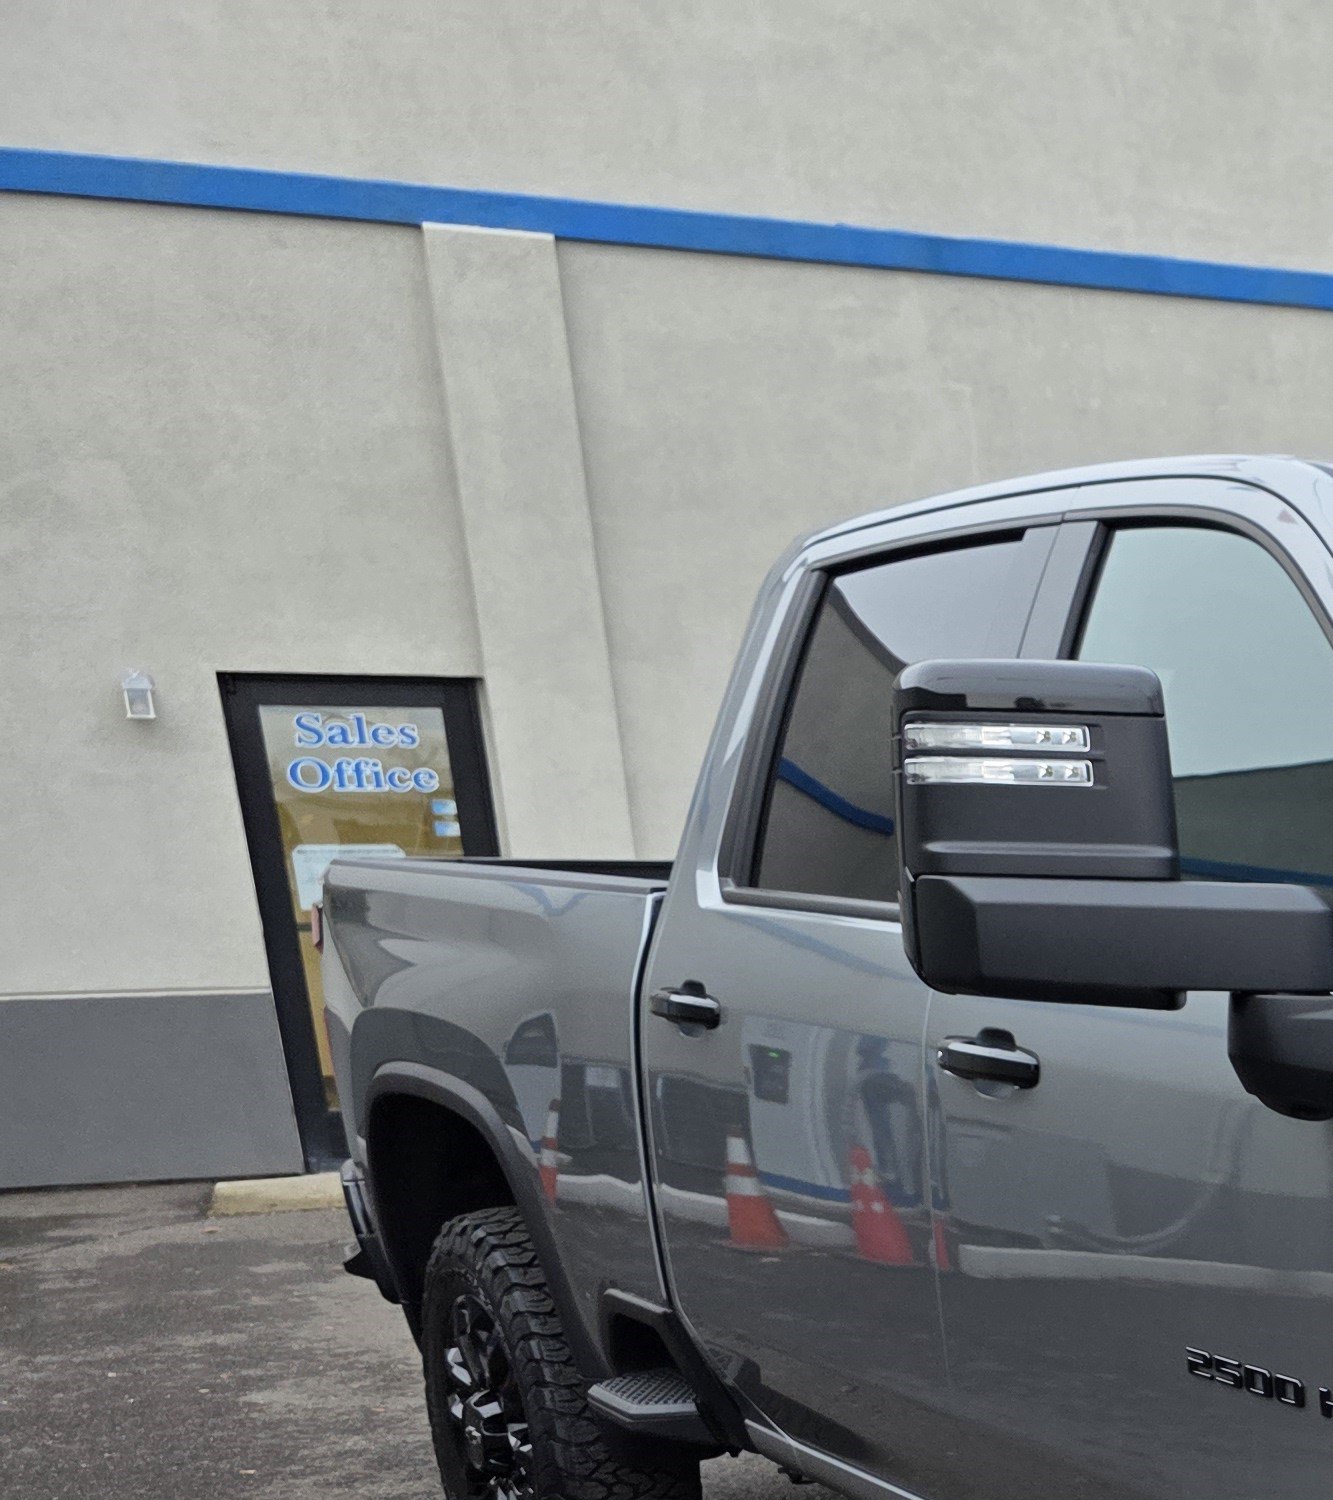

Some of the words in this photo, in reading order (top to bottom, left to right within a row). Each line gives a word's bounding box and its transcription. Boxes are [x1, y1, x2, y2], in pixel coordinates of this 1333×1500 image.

[293, 711, 420, 749] Sales
[287, 756, 440, 793] Office
[1185, 1346, 1306, 1408] 2500
